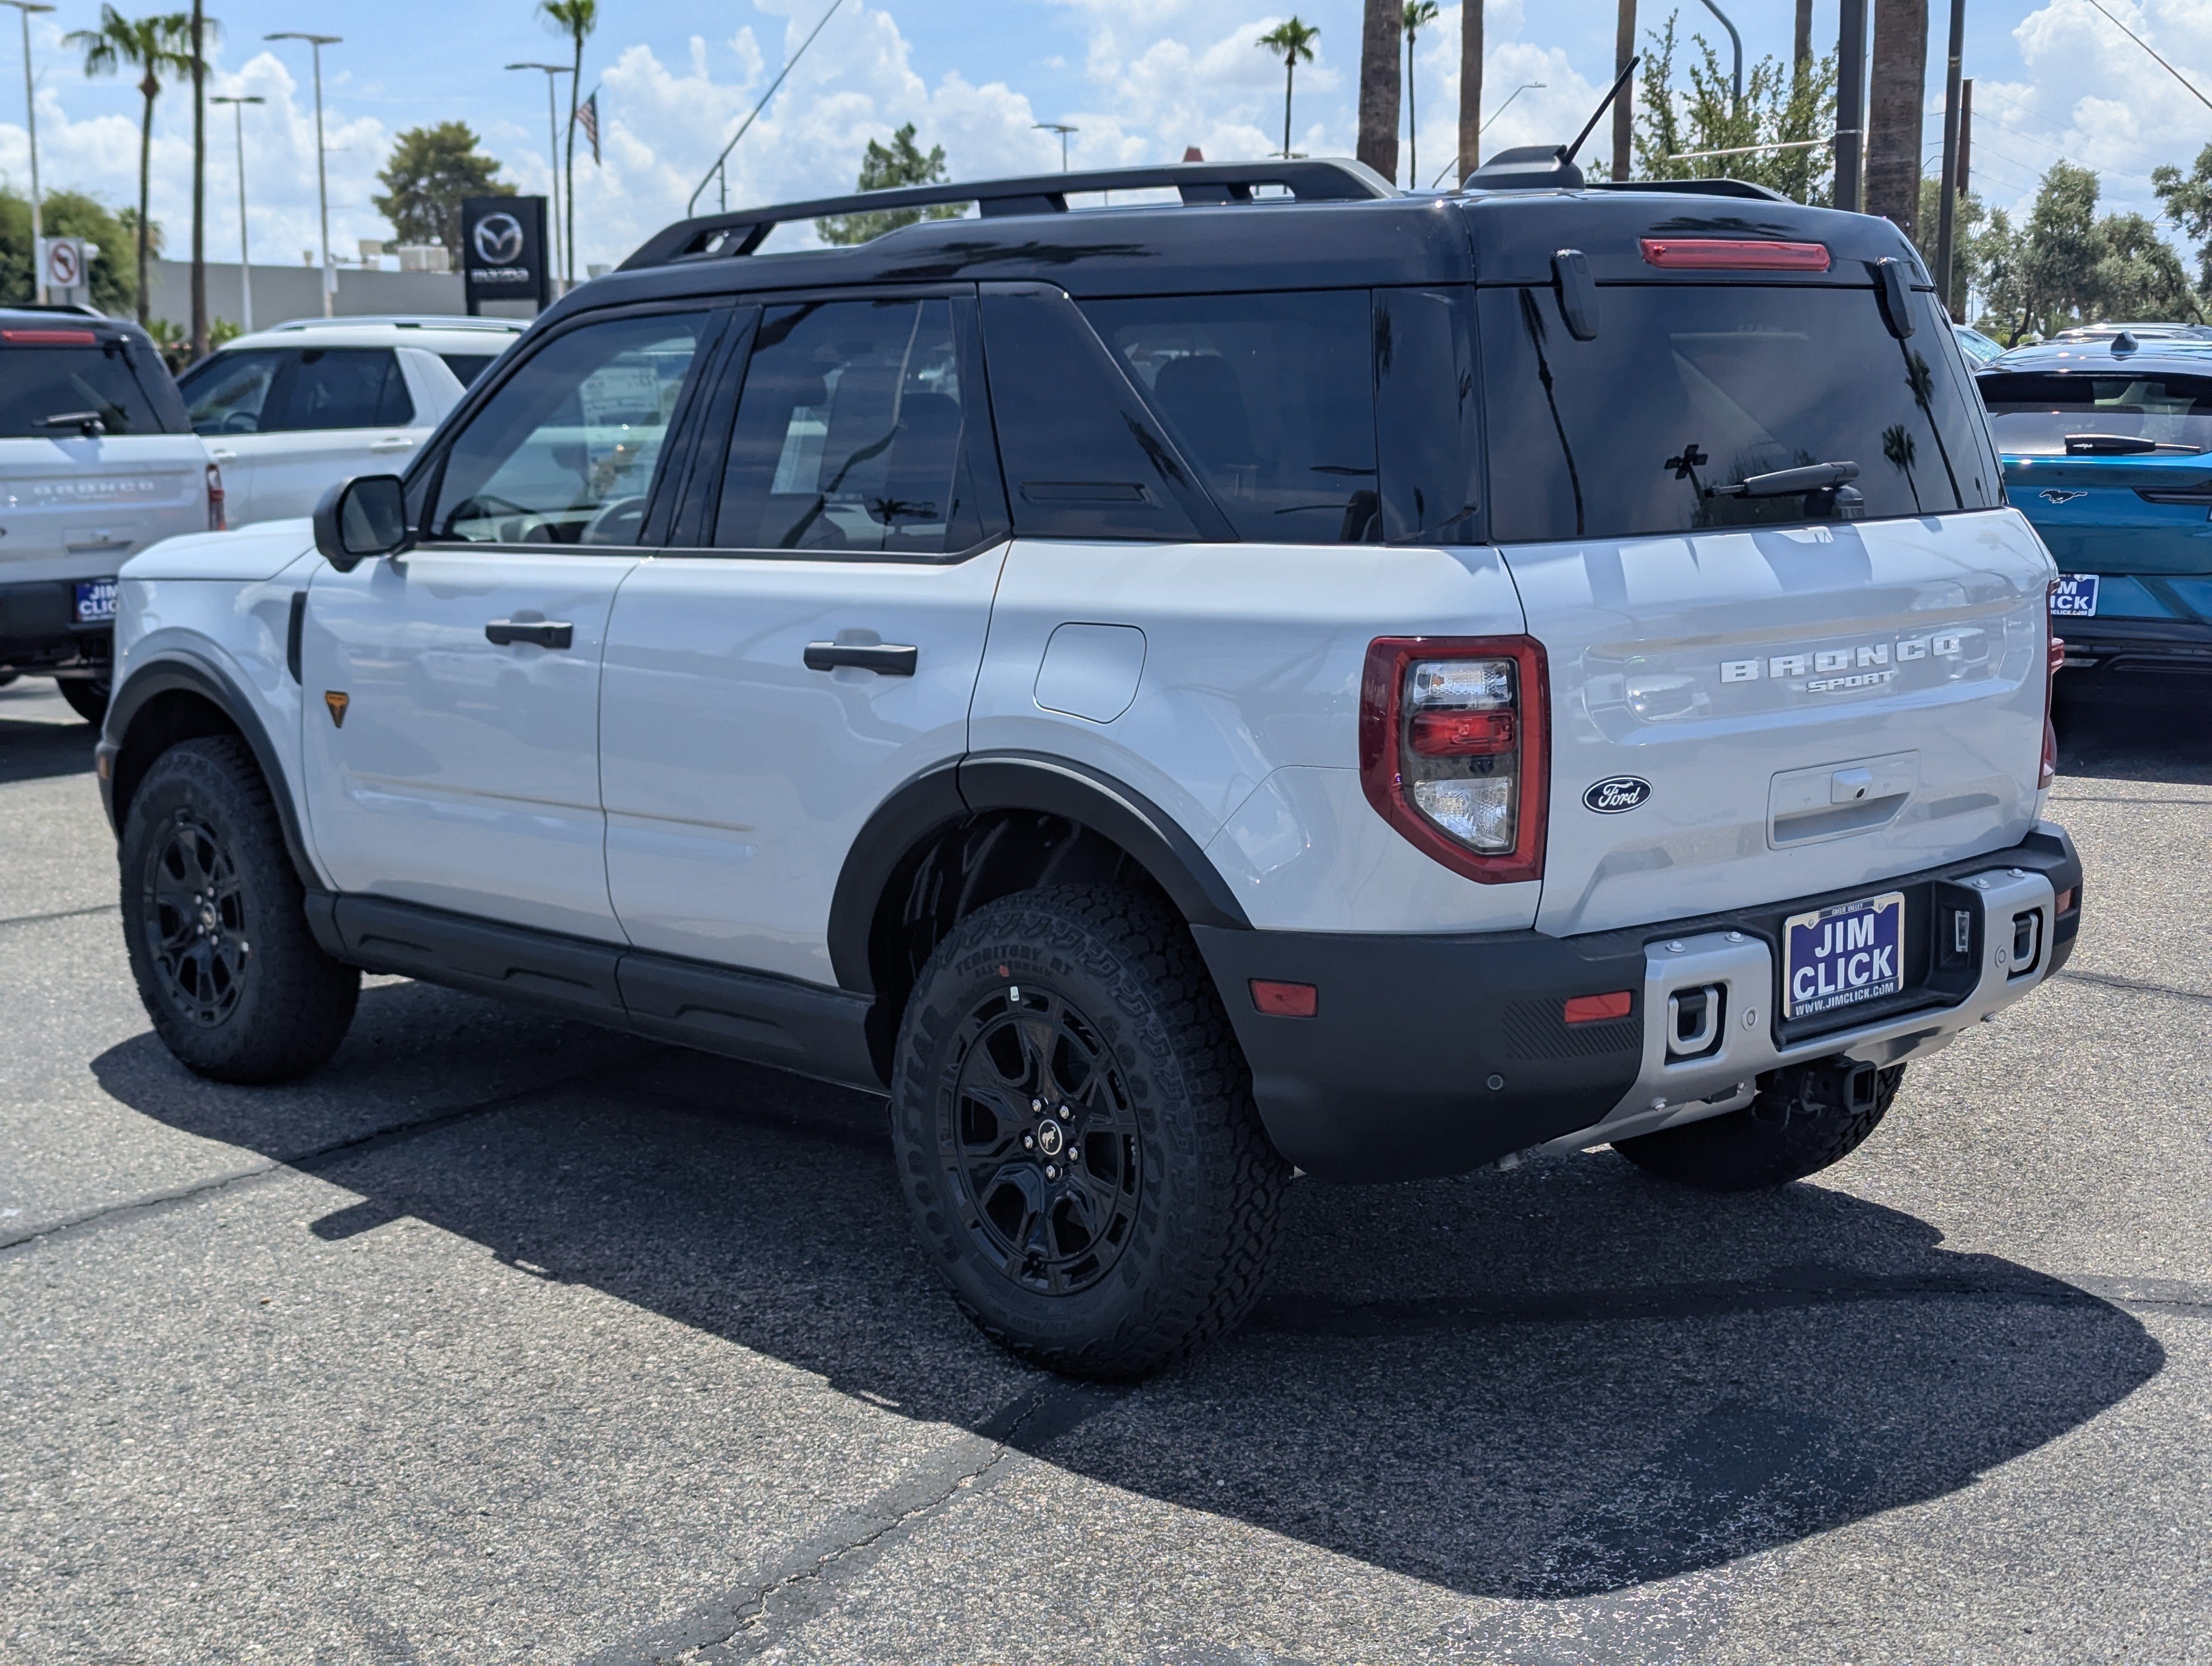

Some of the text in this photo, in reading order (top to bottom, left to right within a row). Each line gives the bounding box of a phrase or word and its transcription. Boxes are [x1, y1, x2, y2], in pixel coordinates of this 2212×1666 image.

[79, 600, 117, 614] CLIC
[2050, 595, 2089, 609] ICK
[1720, 634, 1960, 683] BRONCO
[1807, 670, 1894, 693] SPORT
[1598, 781, 1641, 808] Ford
[1831, 902, 1863, 915] GREEN VALLEY
[1815, 913, 1874, 958] JIM
[954, 944, 1042, 978] TERRITORY
[1793, 945, 1893, 1001] CLICK
[1796, 982, 1894, 1016] WWW.JIMCLICK.COM
